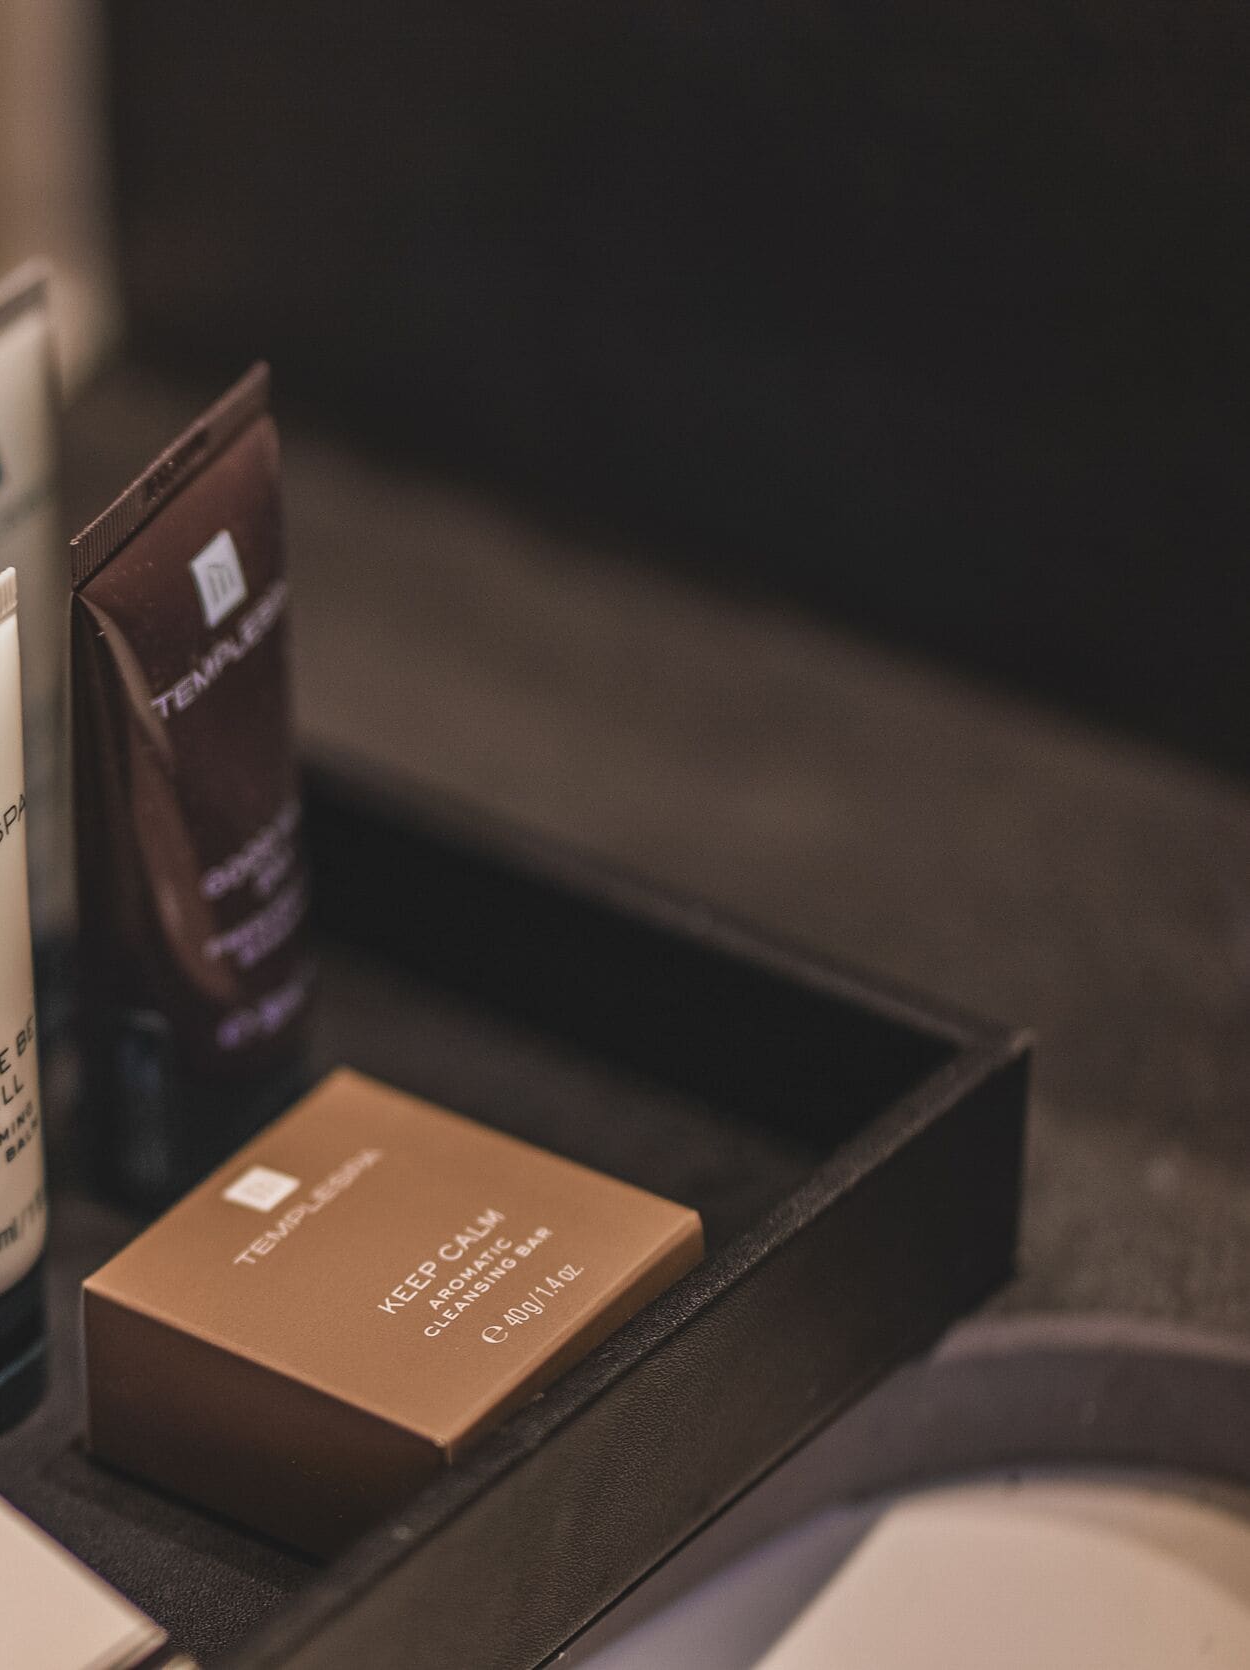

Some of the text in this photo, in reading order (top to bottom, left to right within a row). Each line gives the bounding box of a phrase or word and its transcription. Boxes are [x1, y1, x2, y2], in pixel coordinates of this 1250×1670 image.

[151, 580, 288, 719] TEMPLES
[377, 1207, 505, 1315] KEEP CALM
[423, 1226, 553, 1337] CLEANSING BAR
[428, 1237, 513, 1310] AROMATIC
